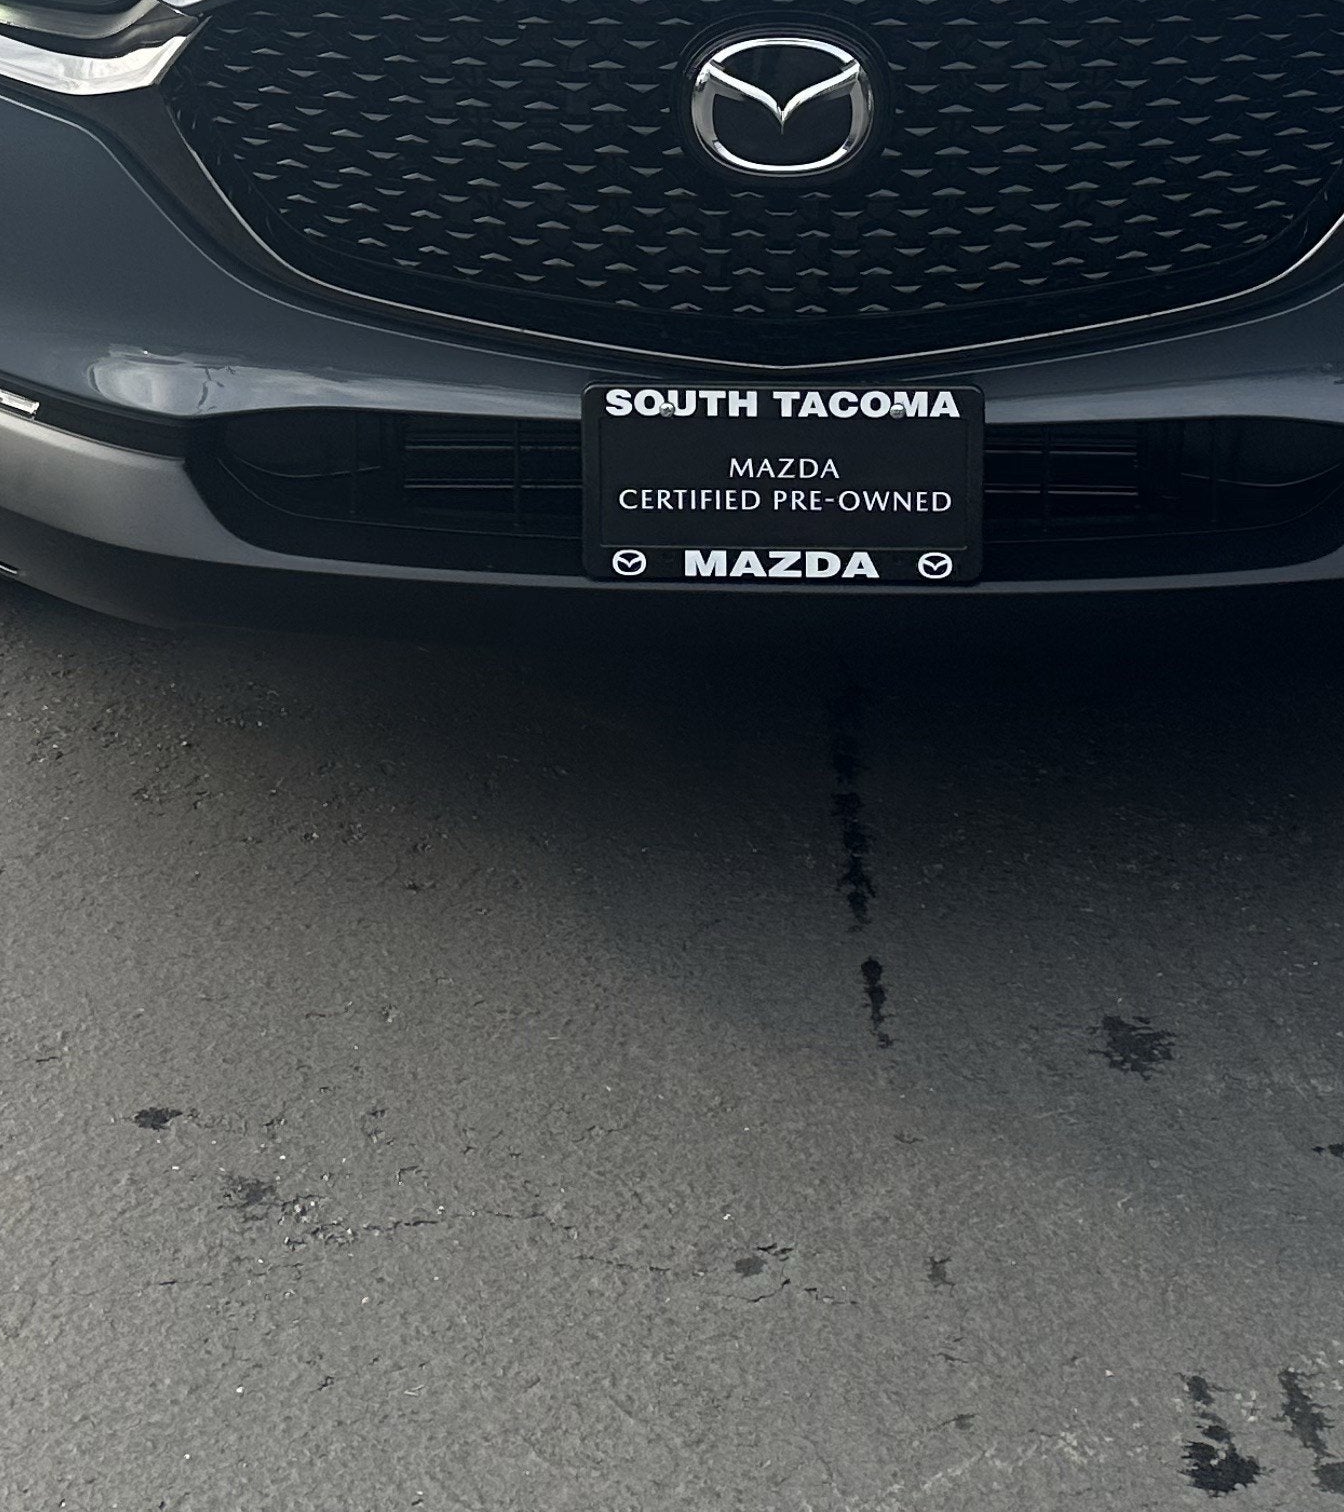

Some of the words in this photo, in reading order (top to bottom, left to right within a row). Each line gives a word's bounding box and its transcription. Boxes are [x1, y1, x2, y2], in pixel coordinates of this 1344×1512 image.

[605, 389, 758, 418] SOUTH
[773, 390, 960, 419] TACOMA
[728, 457, 840, 480] MAZDA
[618, 489, 761, 511] CERTIFIED
[773, 490, 952, 513] PRE-OWNED
[684, 550, 880, 579] MAZDA
